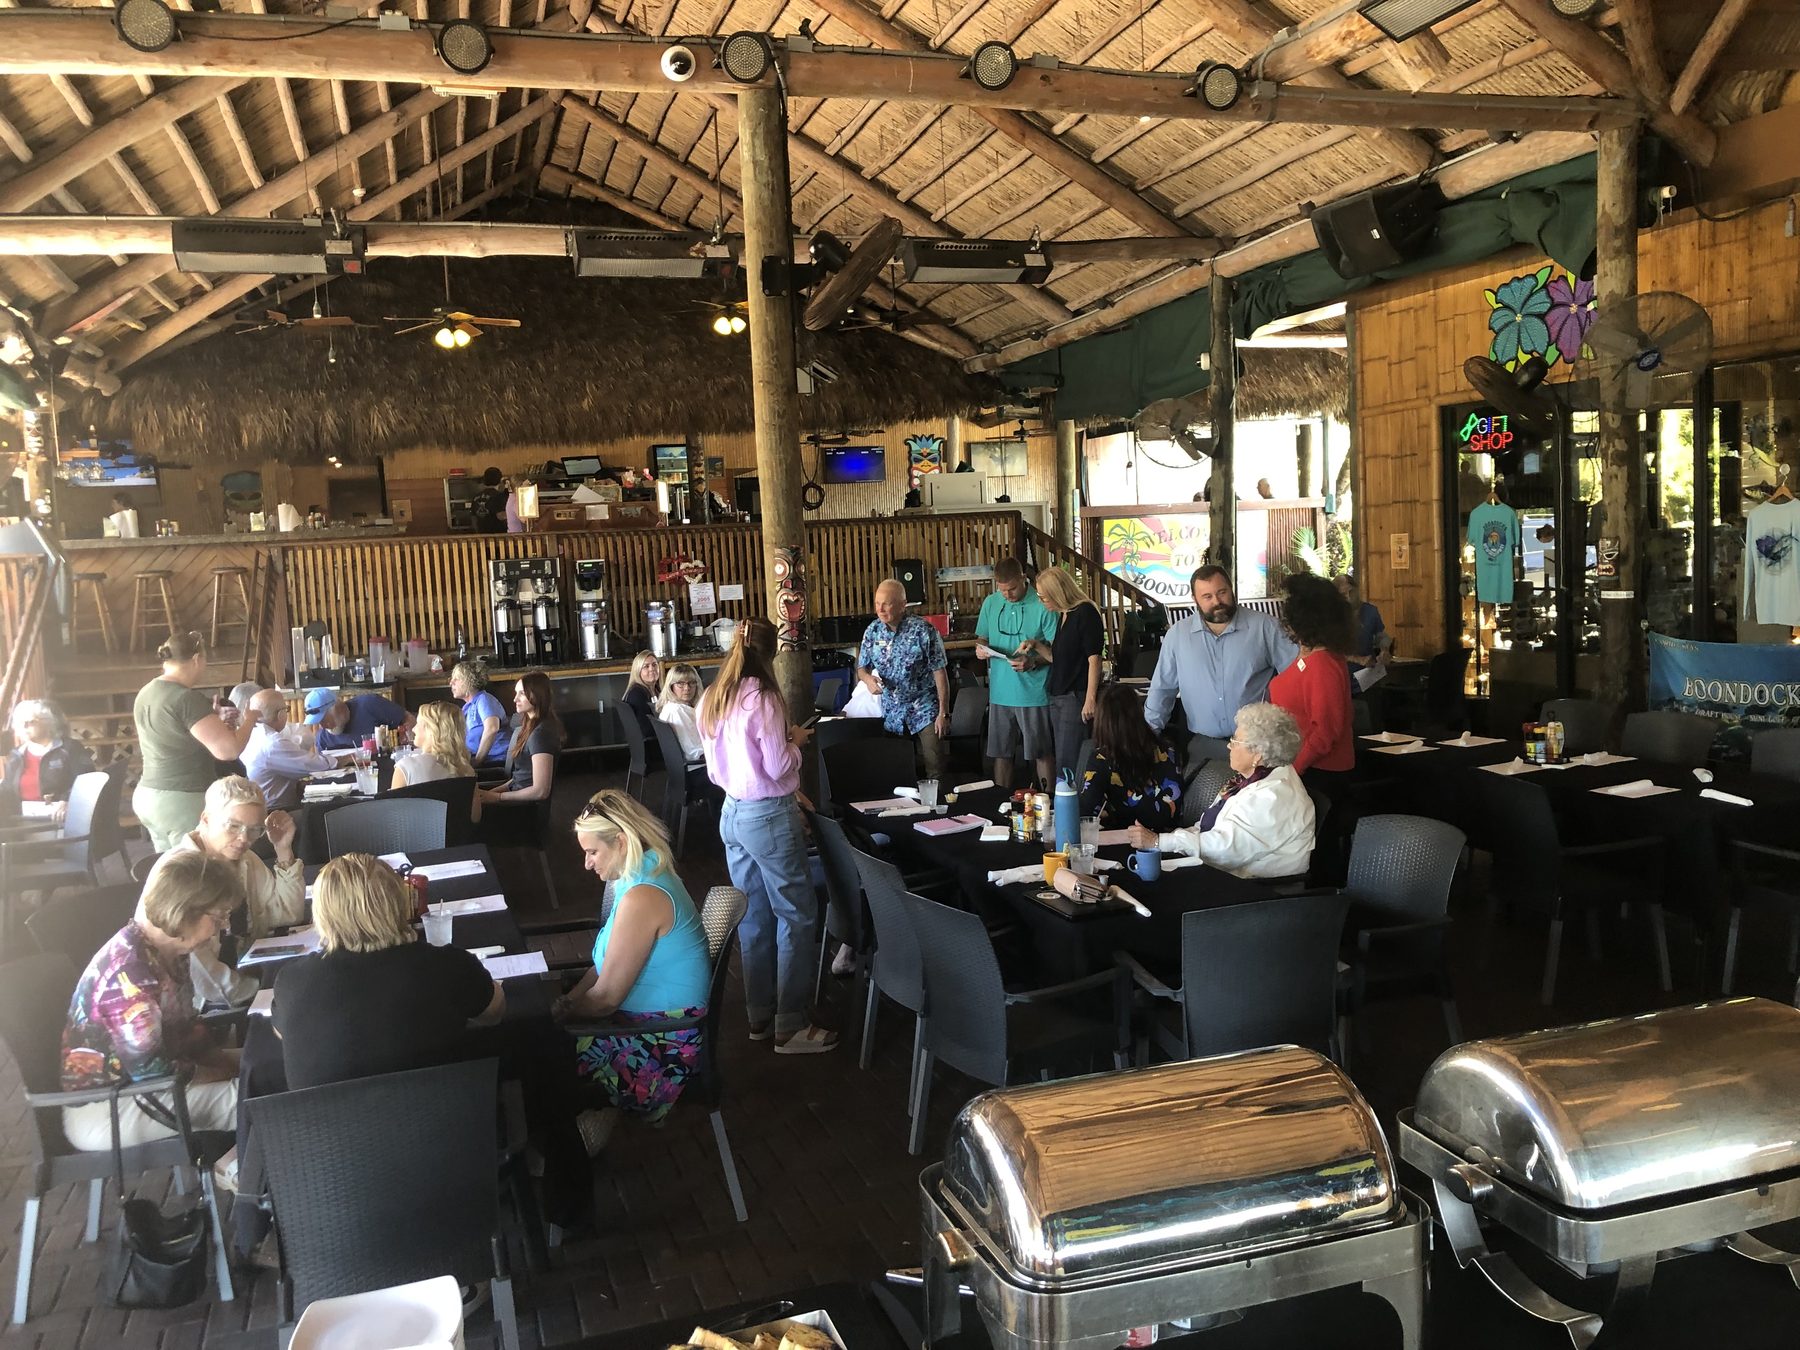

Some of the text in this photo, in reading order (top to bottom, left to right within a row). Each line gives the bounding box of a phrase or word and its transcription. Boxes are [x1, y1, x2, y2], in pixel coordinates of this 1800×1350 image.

[1477, 415, 1508, 434] GIFT
[1470, 432, 1513, 451] SHOP
[1174, 554, 1195, 567] TO
[1132, 572, 1190, 597] BOOND
